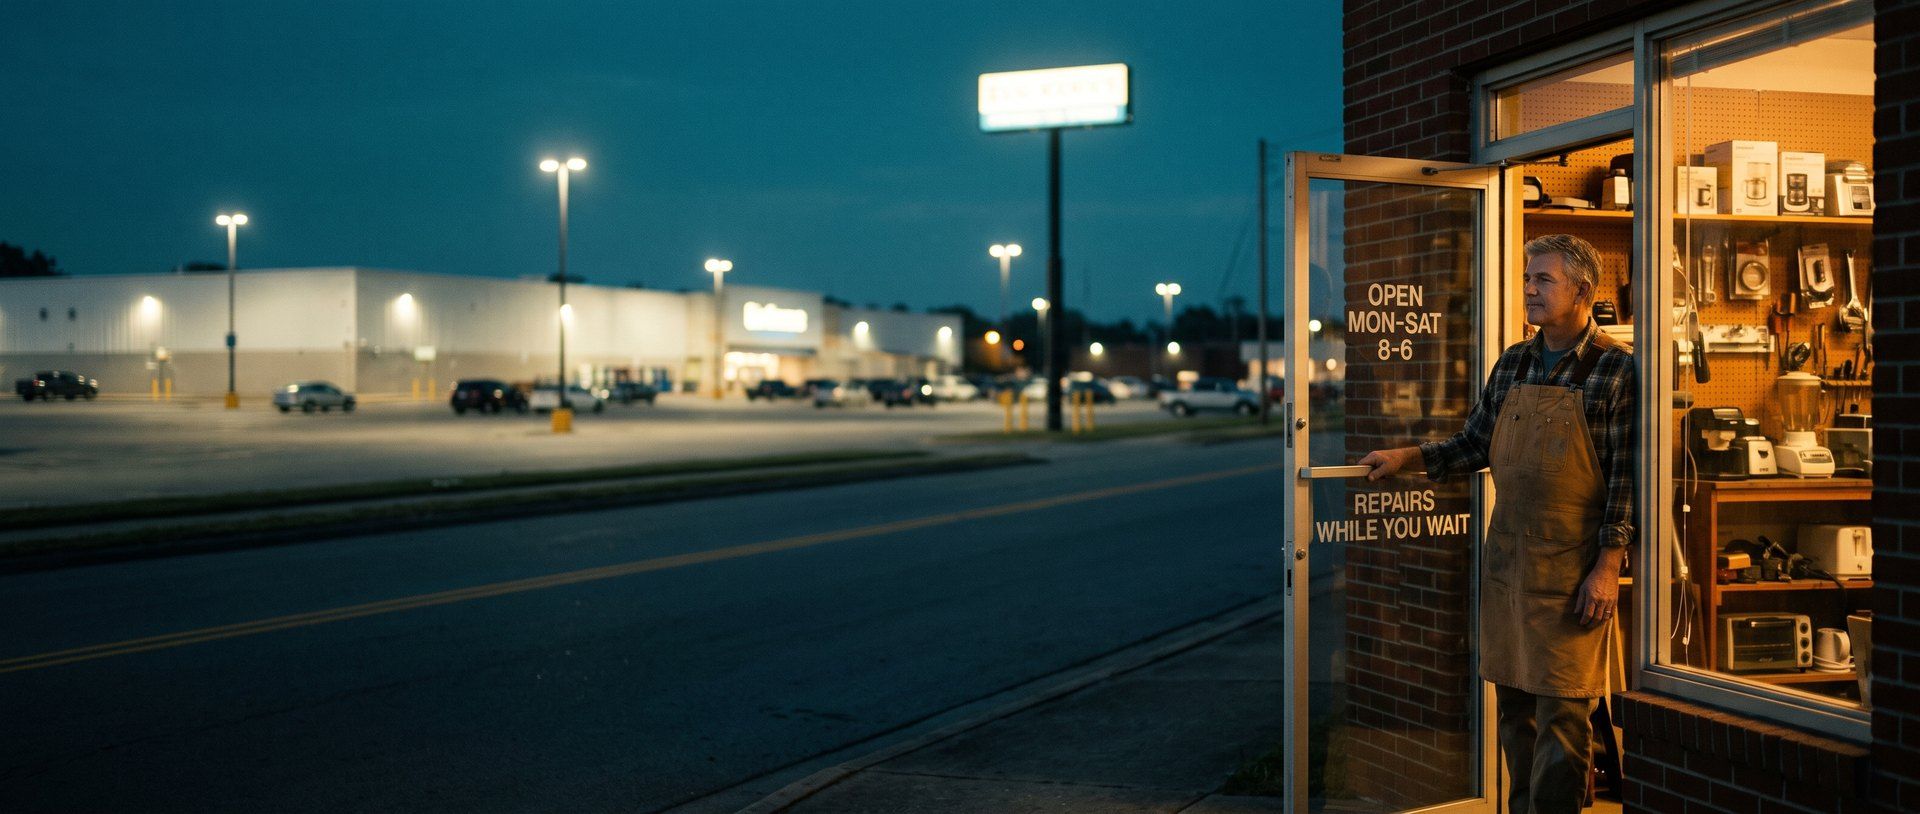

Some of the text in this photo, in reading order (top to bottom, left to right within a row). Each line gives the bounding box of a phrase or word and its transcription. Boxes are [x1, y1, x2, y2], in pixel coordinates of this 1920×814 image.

[1368, 283, 1423, 307] OPEN
[1348, 310, 1442, 334] MON-SAT
[1377, 338, 1413, 361] 8-6
[1354, 489, 1435, 515] REPAIRS
[1316, 513, 1470, 543] WHILE YOU WAIT
